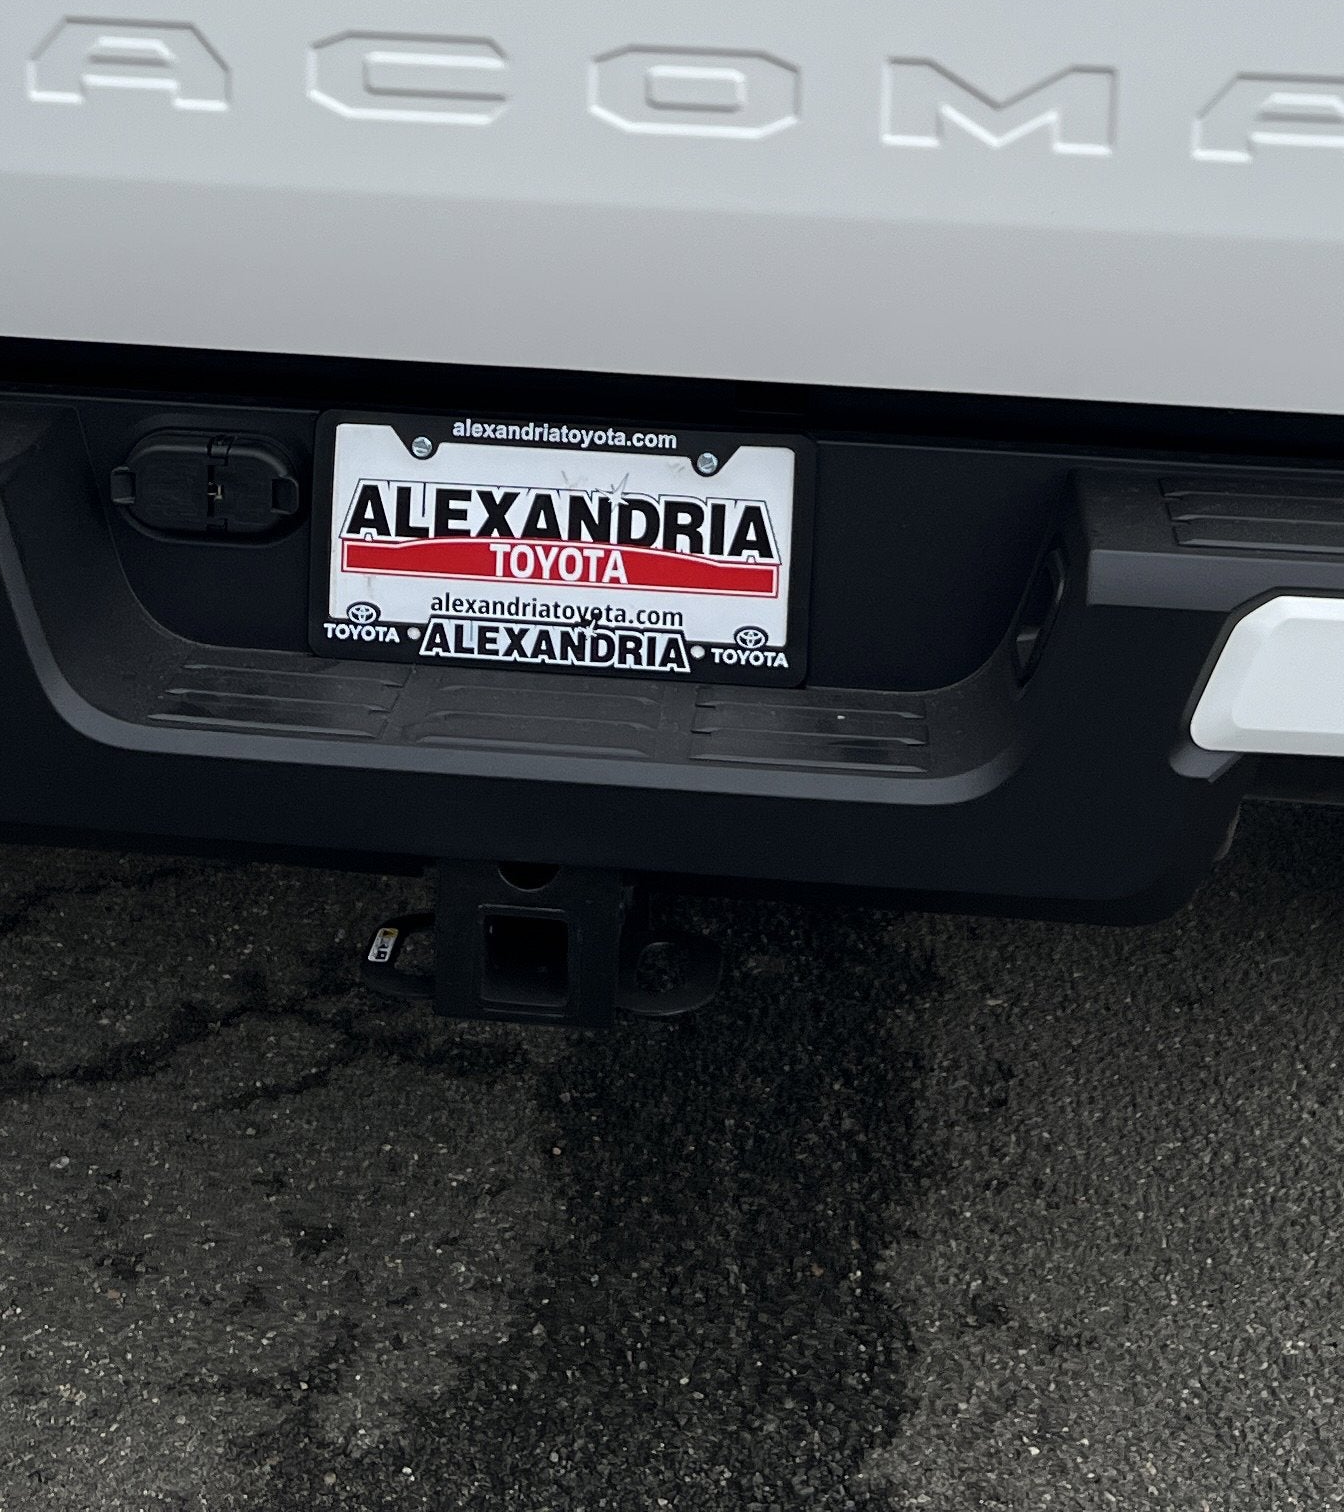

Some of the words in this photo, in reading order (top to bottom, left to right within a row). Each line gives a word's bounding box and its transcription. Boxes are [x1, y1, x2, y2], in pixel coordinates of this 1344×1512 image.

[452, 418, 678, 450] alexandriatoyota.com
[344, 482, 776, 560] ALEXANDRIA
[490, 544, 629, 585] TOYOTA
[430, 592, 684, 628] alexandriatoyota.com
[324, 622, 400, 644] TOYOTA
[423, 619, 688, 671] ALEXANDRIA
[712, 648, 789, 669] TOYOTA
